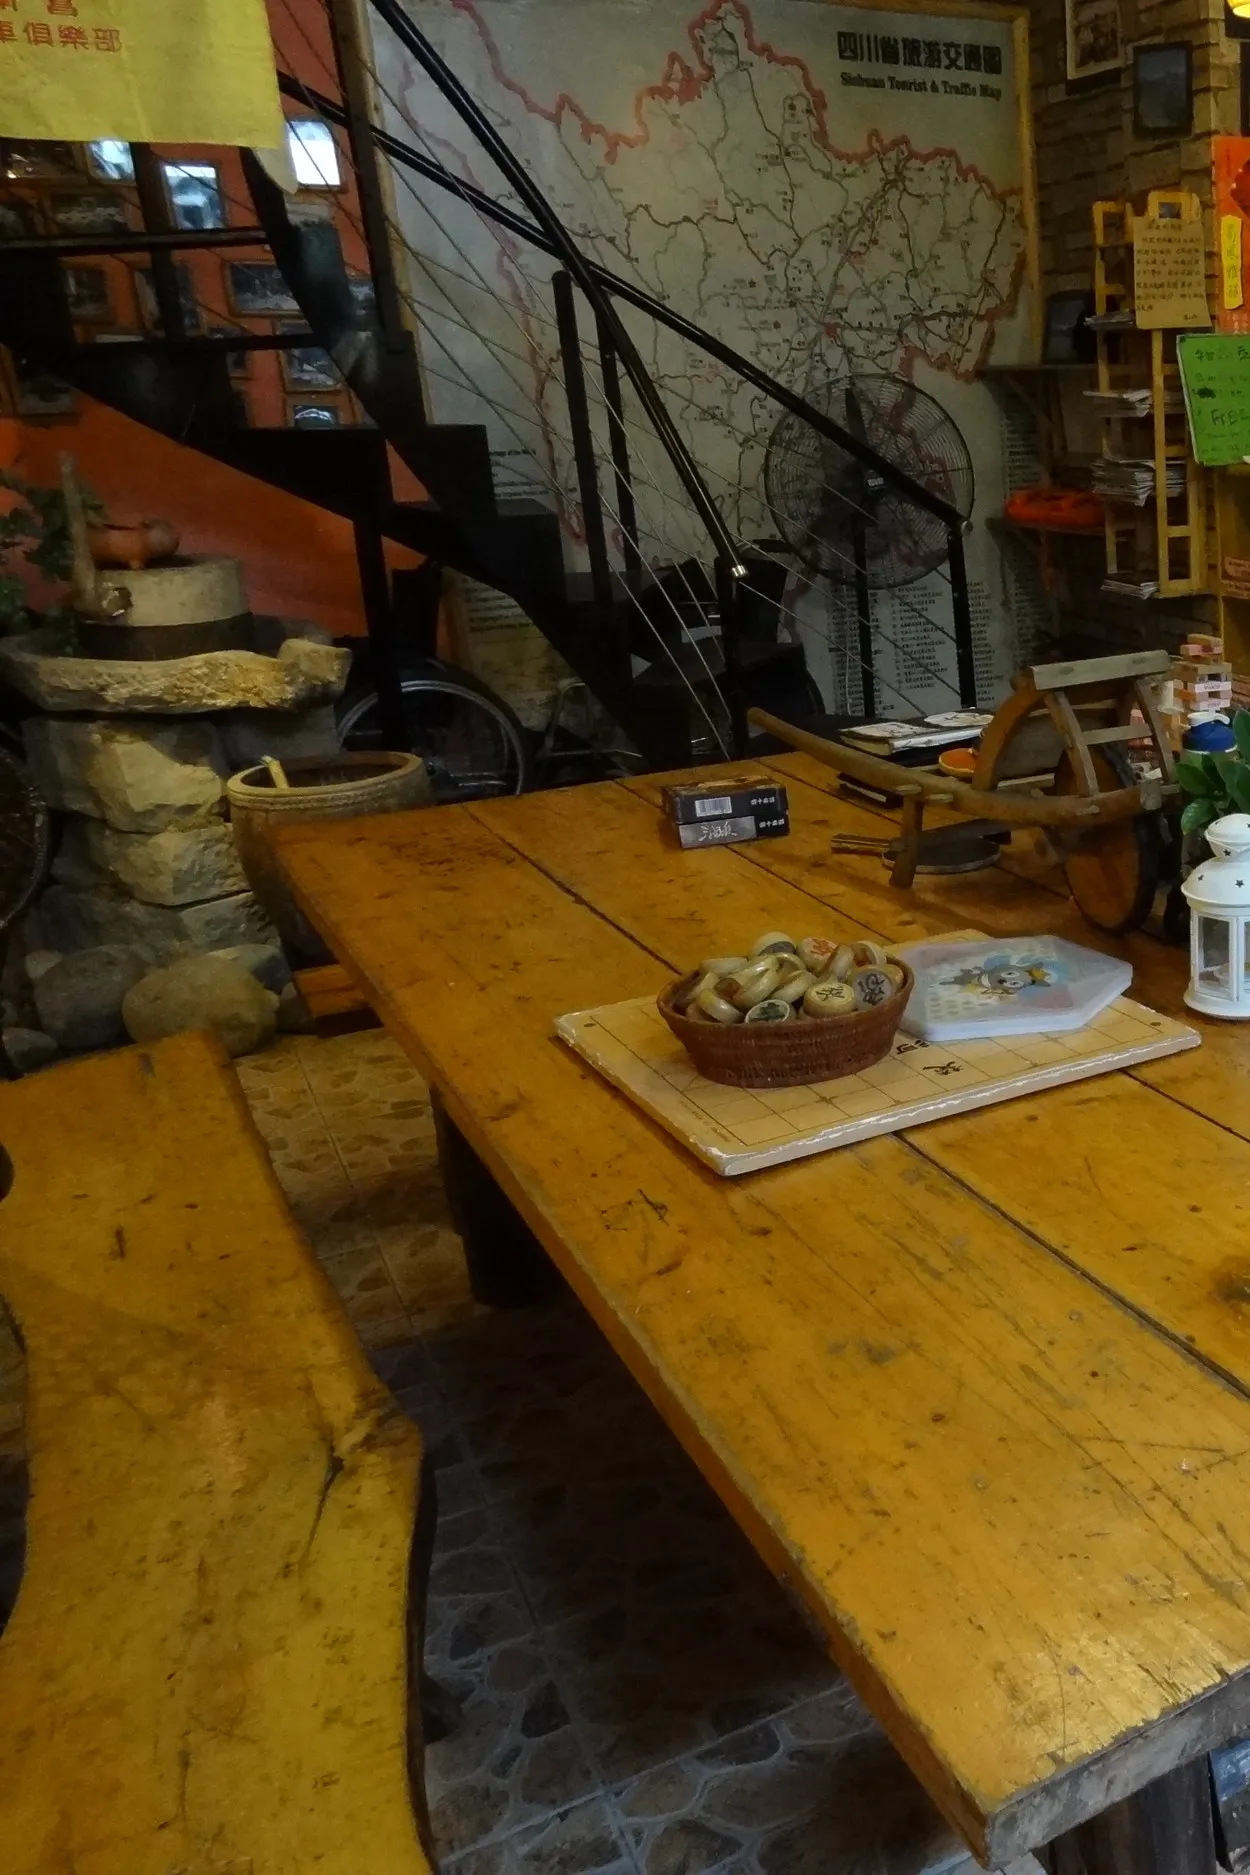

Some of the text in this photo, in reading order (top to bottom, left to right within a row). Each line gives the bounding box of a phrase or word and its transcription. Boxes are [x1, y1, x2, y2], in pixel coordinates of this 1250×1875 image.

[840, 71, 885, 89] Sichuan
[887, 76, 928, 92] Tourist
[979, 83, 1002, 102] Map
